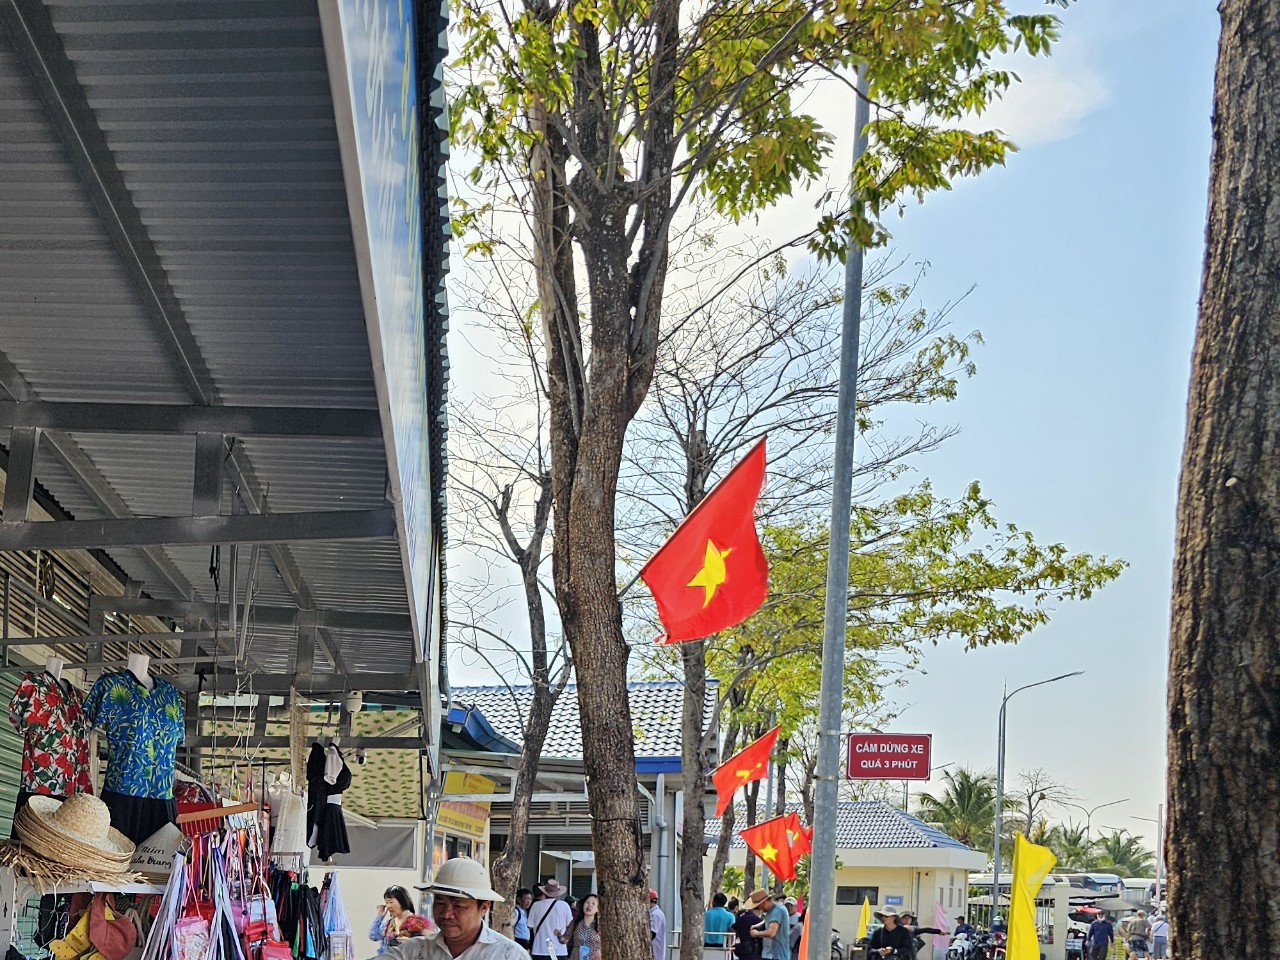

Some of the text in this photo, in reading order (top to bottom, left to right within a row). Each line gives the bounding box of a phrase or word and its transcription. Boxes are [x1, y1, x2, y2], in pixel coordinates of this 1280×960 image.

[910, 744, 924, 754] XE
[860, 758, 918, 769] QUÁ 3 PHÚT
